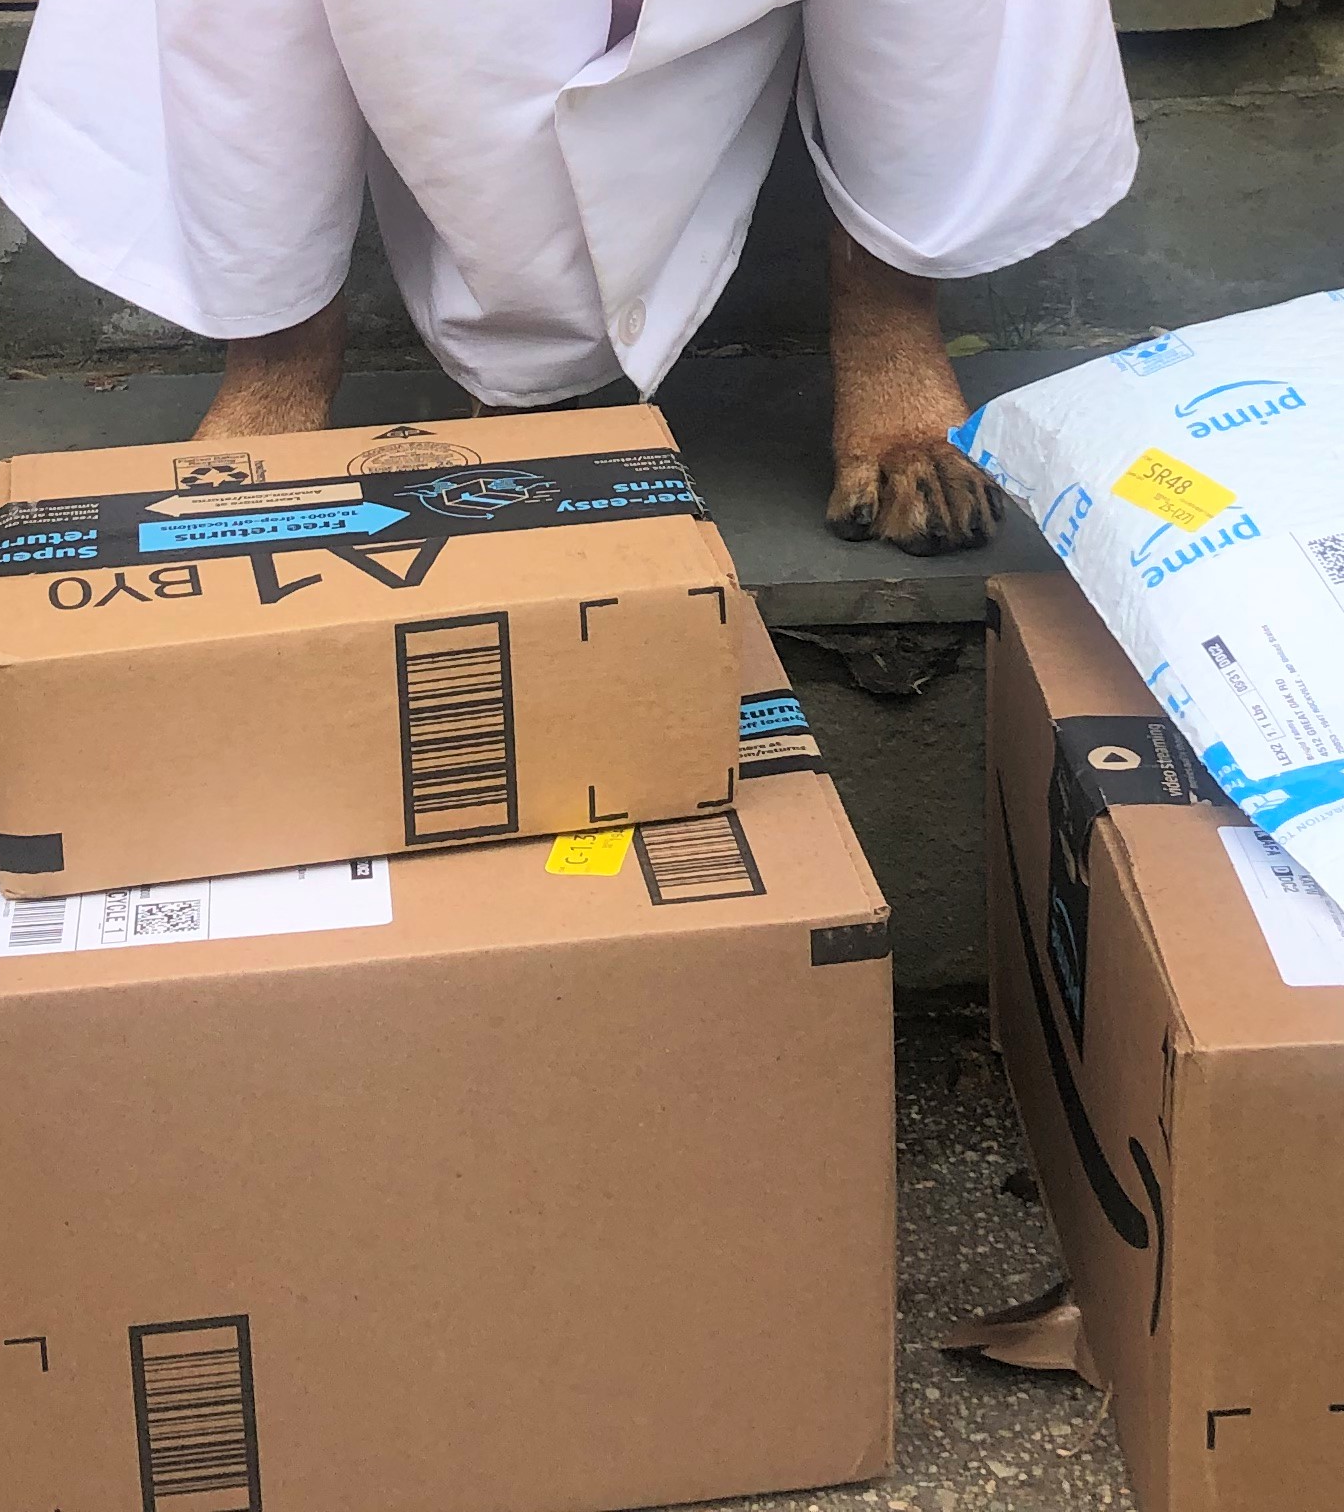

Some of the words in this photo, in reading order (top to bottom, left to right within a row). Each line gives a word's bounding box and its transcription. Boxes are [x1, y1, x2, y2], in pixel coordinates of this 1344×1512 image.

[1188, 386, 1307, 440] prime
[1143, 462, 1194, 496] SR48
[160, 520, 232, 532] locations
[175, 524, 279, 542] returns
[234, 515, 299, 527] drop-off
[288, 519, 348, 533] Free
[1142, 506, 1262, 589] prime
[1207, 642, 1232, 669] DDC2
[1274, 678, 1289, 692] RD
[1295, 708, 1317, 737] GREAT
[1270, 742, 1294, 767] LEX2
[1162, 766, 1183, 797] video
[565, 834, 596, 864] C-1.3
[1272, 864, 1300, 894] DDC2
